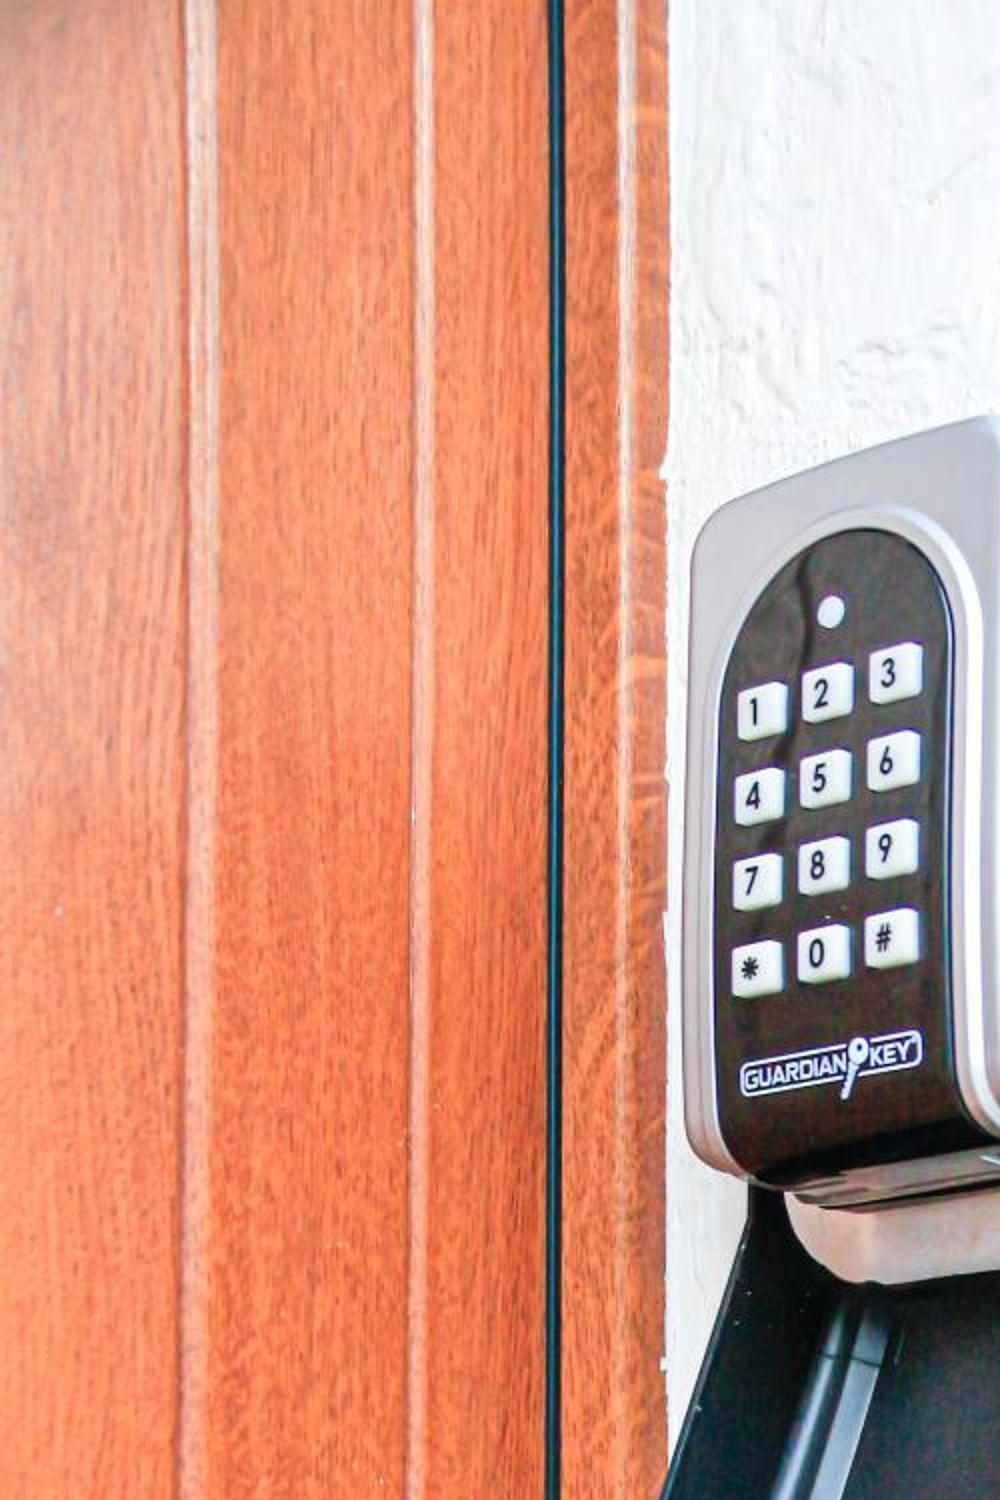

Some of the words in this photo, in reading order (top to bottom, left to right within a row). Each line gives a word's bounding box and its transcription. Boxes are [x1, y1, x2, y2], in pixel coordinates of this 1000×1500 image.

[749, 697, 758, 727] 1
[813, 679, 829, 710] 2
[880, 658, 896, 689] 3
[745, 781, 761, 810] 4
[811, 763, 827, 794] 5
[878, 745, 894, 776] 6
[744, 865, 759, 897] 7
[809, 849, 826, 881] 8
[877, 833, 893, 863] 9
[808, 937, 825, 969] 0
[875, 922, 893, 953] #
[745, 1052, 848, 1090] GUARDIAN
[869, 1041, 909, 1067] KEY
